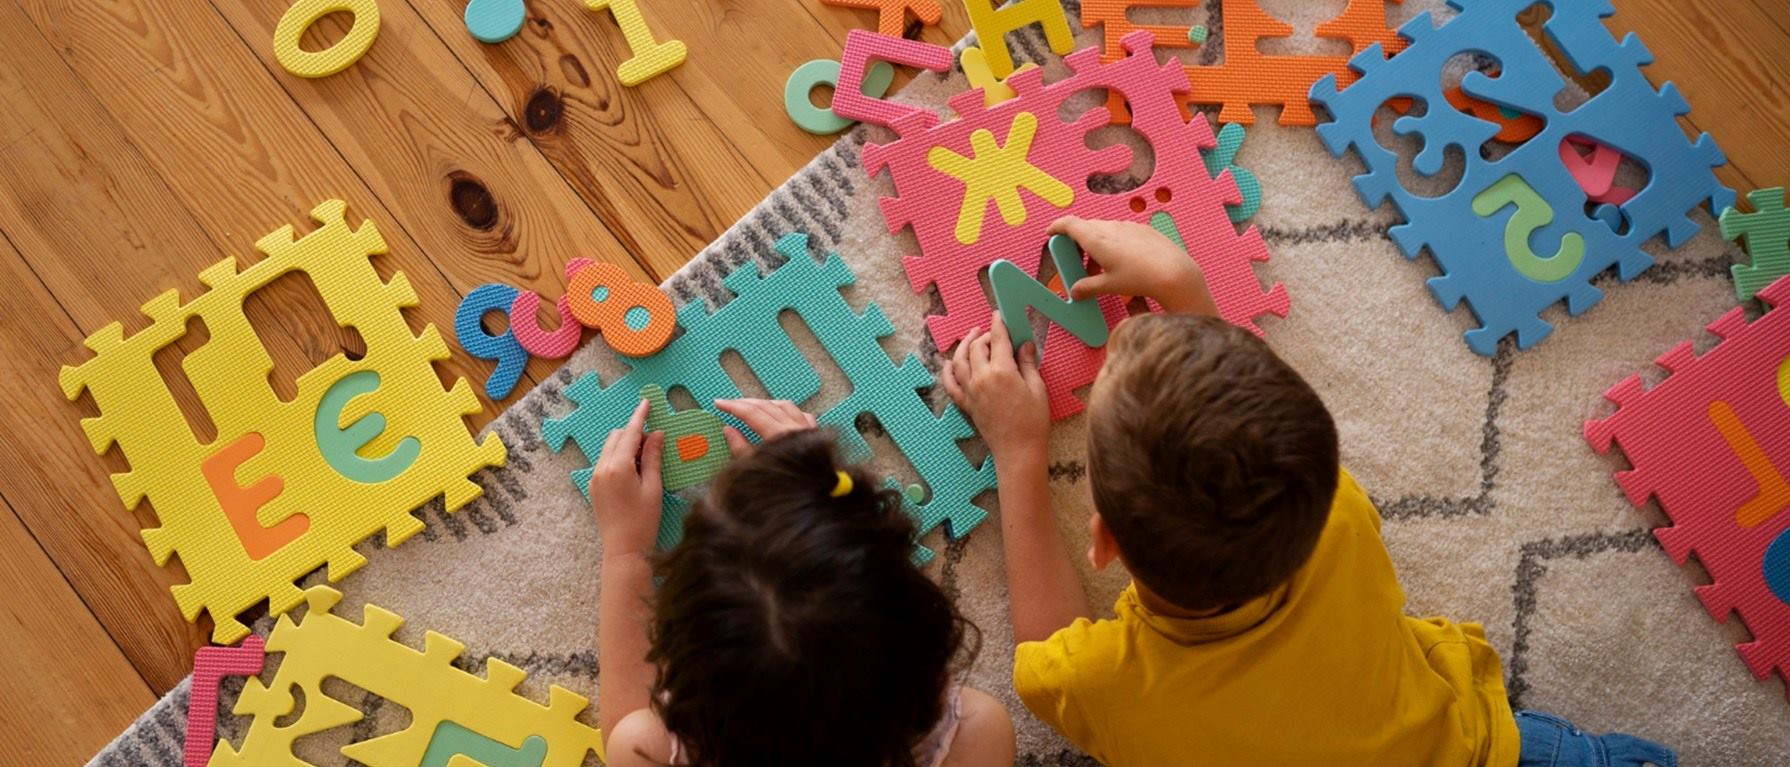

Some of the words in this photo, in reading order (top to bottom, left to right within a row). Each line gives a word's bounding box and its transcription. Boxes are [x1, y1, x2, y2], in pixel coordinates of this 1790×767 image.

[927, 111, 1075, 245] Ж
[455, 283, 528, 400] 9
[567, 262, 677, 357] 8
